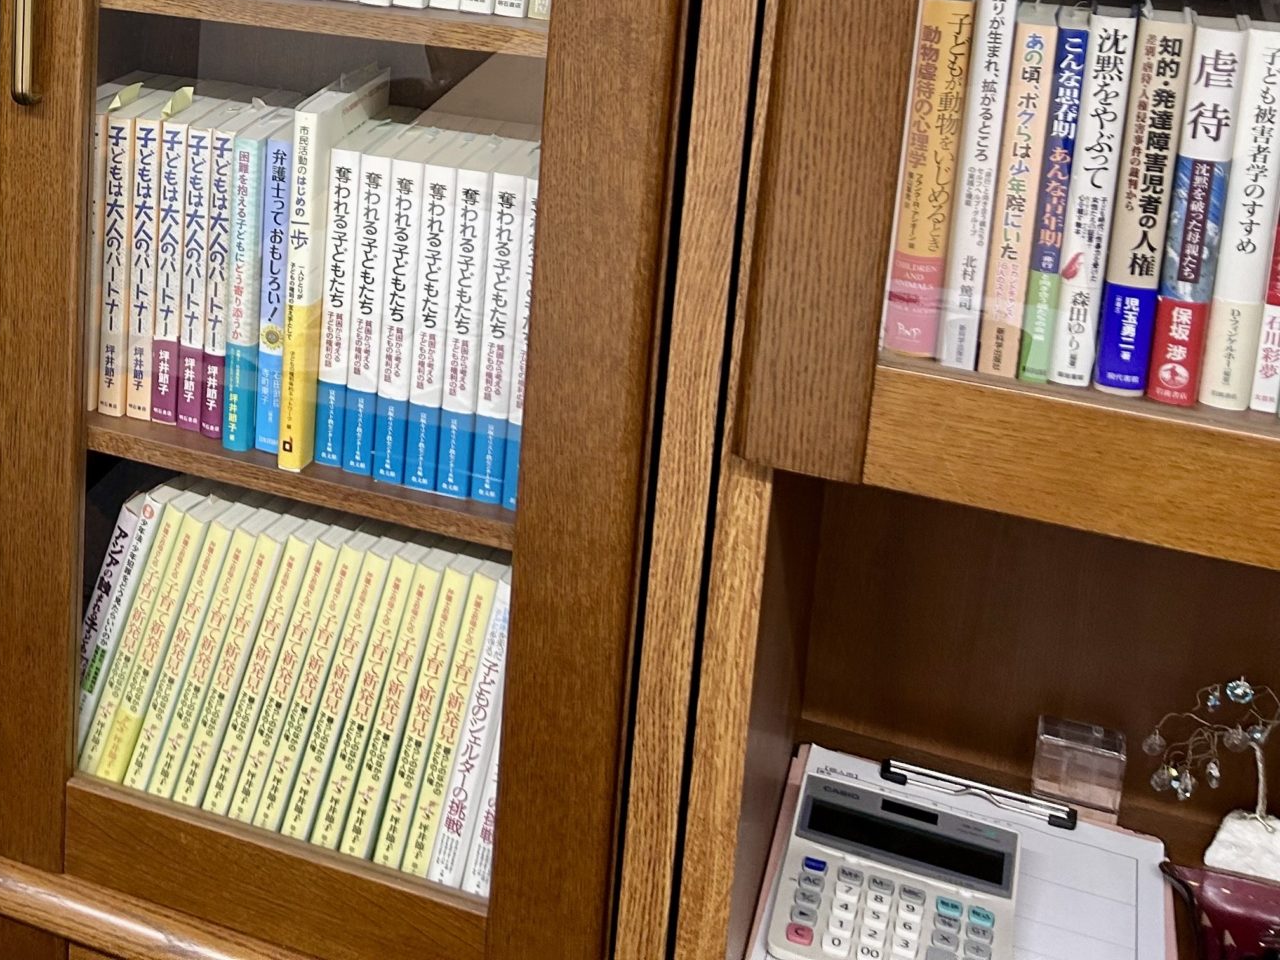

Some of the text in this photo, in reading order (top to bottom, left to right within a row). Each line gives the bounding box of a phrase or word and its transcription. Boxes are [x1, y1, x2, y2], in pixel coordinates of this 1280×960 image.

[908, 25, 942, 168] 動物虐待の心理学
[927, 13, 972, 252] 子どもが動物をいじめるとき
[1051, 37, 1084, 139] こんな思春期
[1084, 28, 1128, 188] 沈黙をやぶって
[1187, 49, 1238, 143] 虐待
[290, 126, 310, 250] 市民活動のはじめの一歩
[1001, 33, 1044, 260] あの頃、ボクらは少年院にいた
[1128, 35, 1183, 277] 知的・発達障害児者の人権
[1236, 47, 1280, 255] 子ども被害者学のすすめ
[105, 126, 127, 331] 子どもは大人のパートナー
[133, 127, 156, 333] 子どもは大人のパートナー
[159, 130, 183, 336] 子どもは大人のパートナー
[184, 135, 208, 344] 子どもは大人のパートナー
[207, 137, 233, 351] 子どもは大人のパートナー
[231, 151, 250, 340] 困難を抱える子どもにどう寄り添うか
[329, 166, 352, 308] 奪われる子どもたち
[358, 172, 383, 315] 奪われる子どもたち
[389, 177, 414, 322] 奪われる子どもたち
[421, 182, 447, 329] 奪われる子どもたち
[454, 188, 480, 335] 奪われる子どもたち
[489, 191, 516, 340] 奪われる子どもたち
[1178, 162, 1212, 280] 沈黙を破った母親たち
[963, 256, 977, 281] 北村
[104, 345, 115, 388] 坪井節子
[1067, 291, 1090, 350] 森田ゆり
[1118, 296, 1140, 350] 児玉勇二
[1166, 307, 1193, 361] 保坂 渉
[133, 347, 144, 390] 坪井節子
[158, 350, 169, 395] 坪井節子
[184, 357, 195, 402] 坪井節子
[206, 365, 218, 411] 坪井節子
[228, 393, 238, 431] 坪井節子
[823, 785, 860, 800] CASIO
[804, 876, 820, 885] AC
[840, 903, 849, 912] 4
[872, 911, 880, 920] 5
[873, 895, 884, 904] 8
[903, 921, 912, 931] 6
[906, 904, 915, 913] 9
[832, 937, 842, 947] 0
[861, 946, 880, 958] 00
[868, 929, 877, 938] 2
[900, 939, 910, 949] 3
